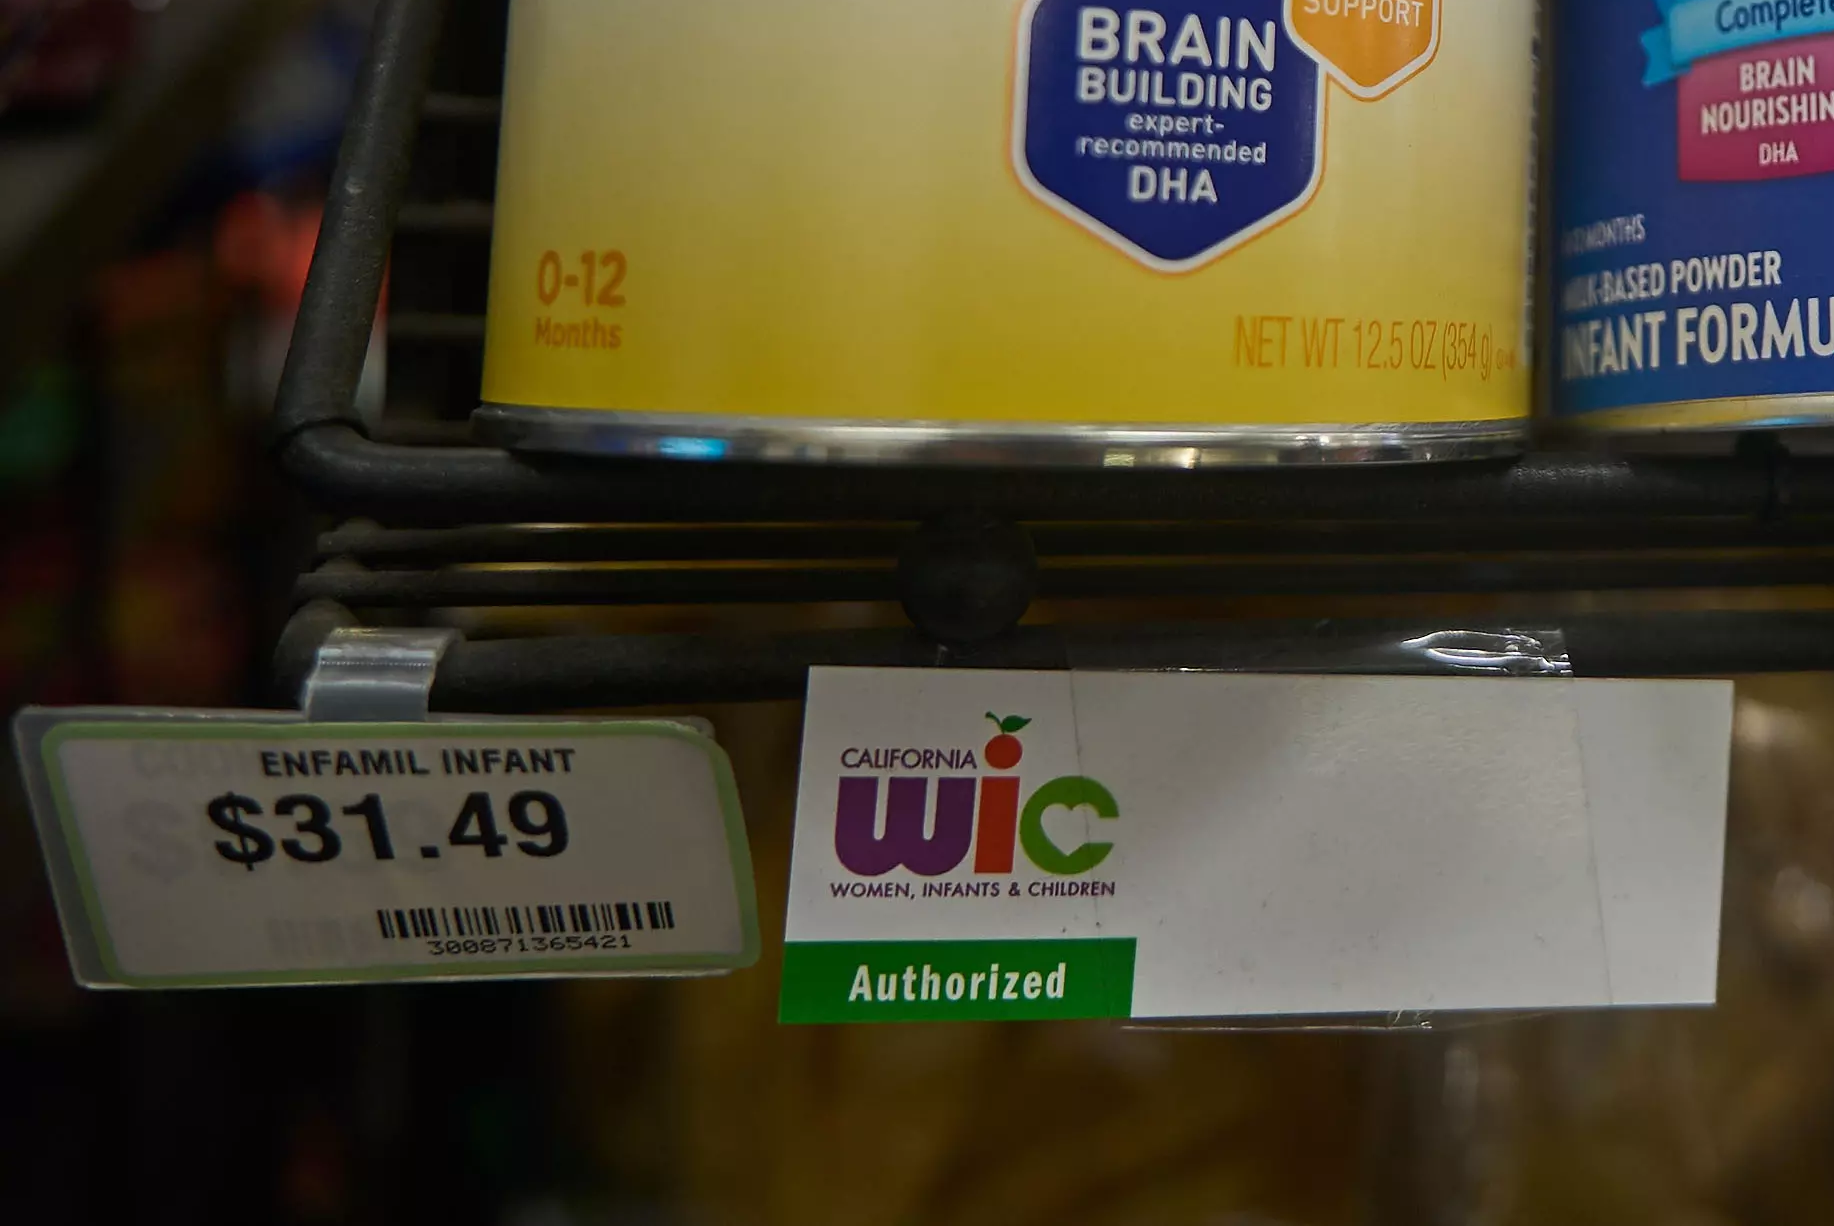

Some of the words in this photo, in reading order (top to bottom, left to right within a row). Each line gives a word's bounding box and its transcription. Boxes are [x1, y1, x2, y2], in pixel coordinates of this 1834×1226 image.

[1078, 6, 1277, 73] BRAIN
[1076, 67, 1273, 112] BUILDING
[1739, 55, 1816, 93] BRAIN
[1128, 111, 1225, 137] expert-
[1076, 134, 1268, 164] recommended
[1758, 140, 1800, 167] DHA
[1130, 164, 1219, 204] DHA
[535, 248, 628, 310] 0-12
[1670, 249, 1783, 295] POWDER
[534, 316, 623, 352] Months
[1234, 315, 1294, 370] NET
[1301, 317, 1346, 370] WT
[1352, 319, 1404, 372] 12.5
[1410, 319, 1438, 371] OZ
[260, 749, 430, 778] ENFAMIL
[442, 749, 576, 776] INFANT
[840, 747, 978, 770] CALIFORNIA
[206, 790, 570, 873] $31.49
[830, 882, 917, 900] WOMEN,
[922, 881, 1001, 899] INFANTS
[1008, 881, 1022, 898] &
[1027, 880, 1116, 898] CHILDREN
[426, 936, 633, 957] 300871365421
[848, 961, 1068, 1002] Authorized
